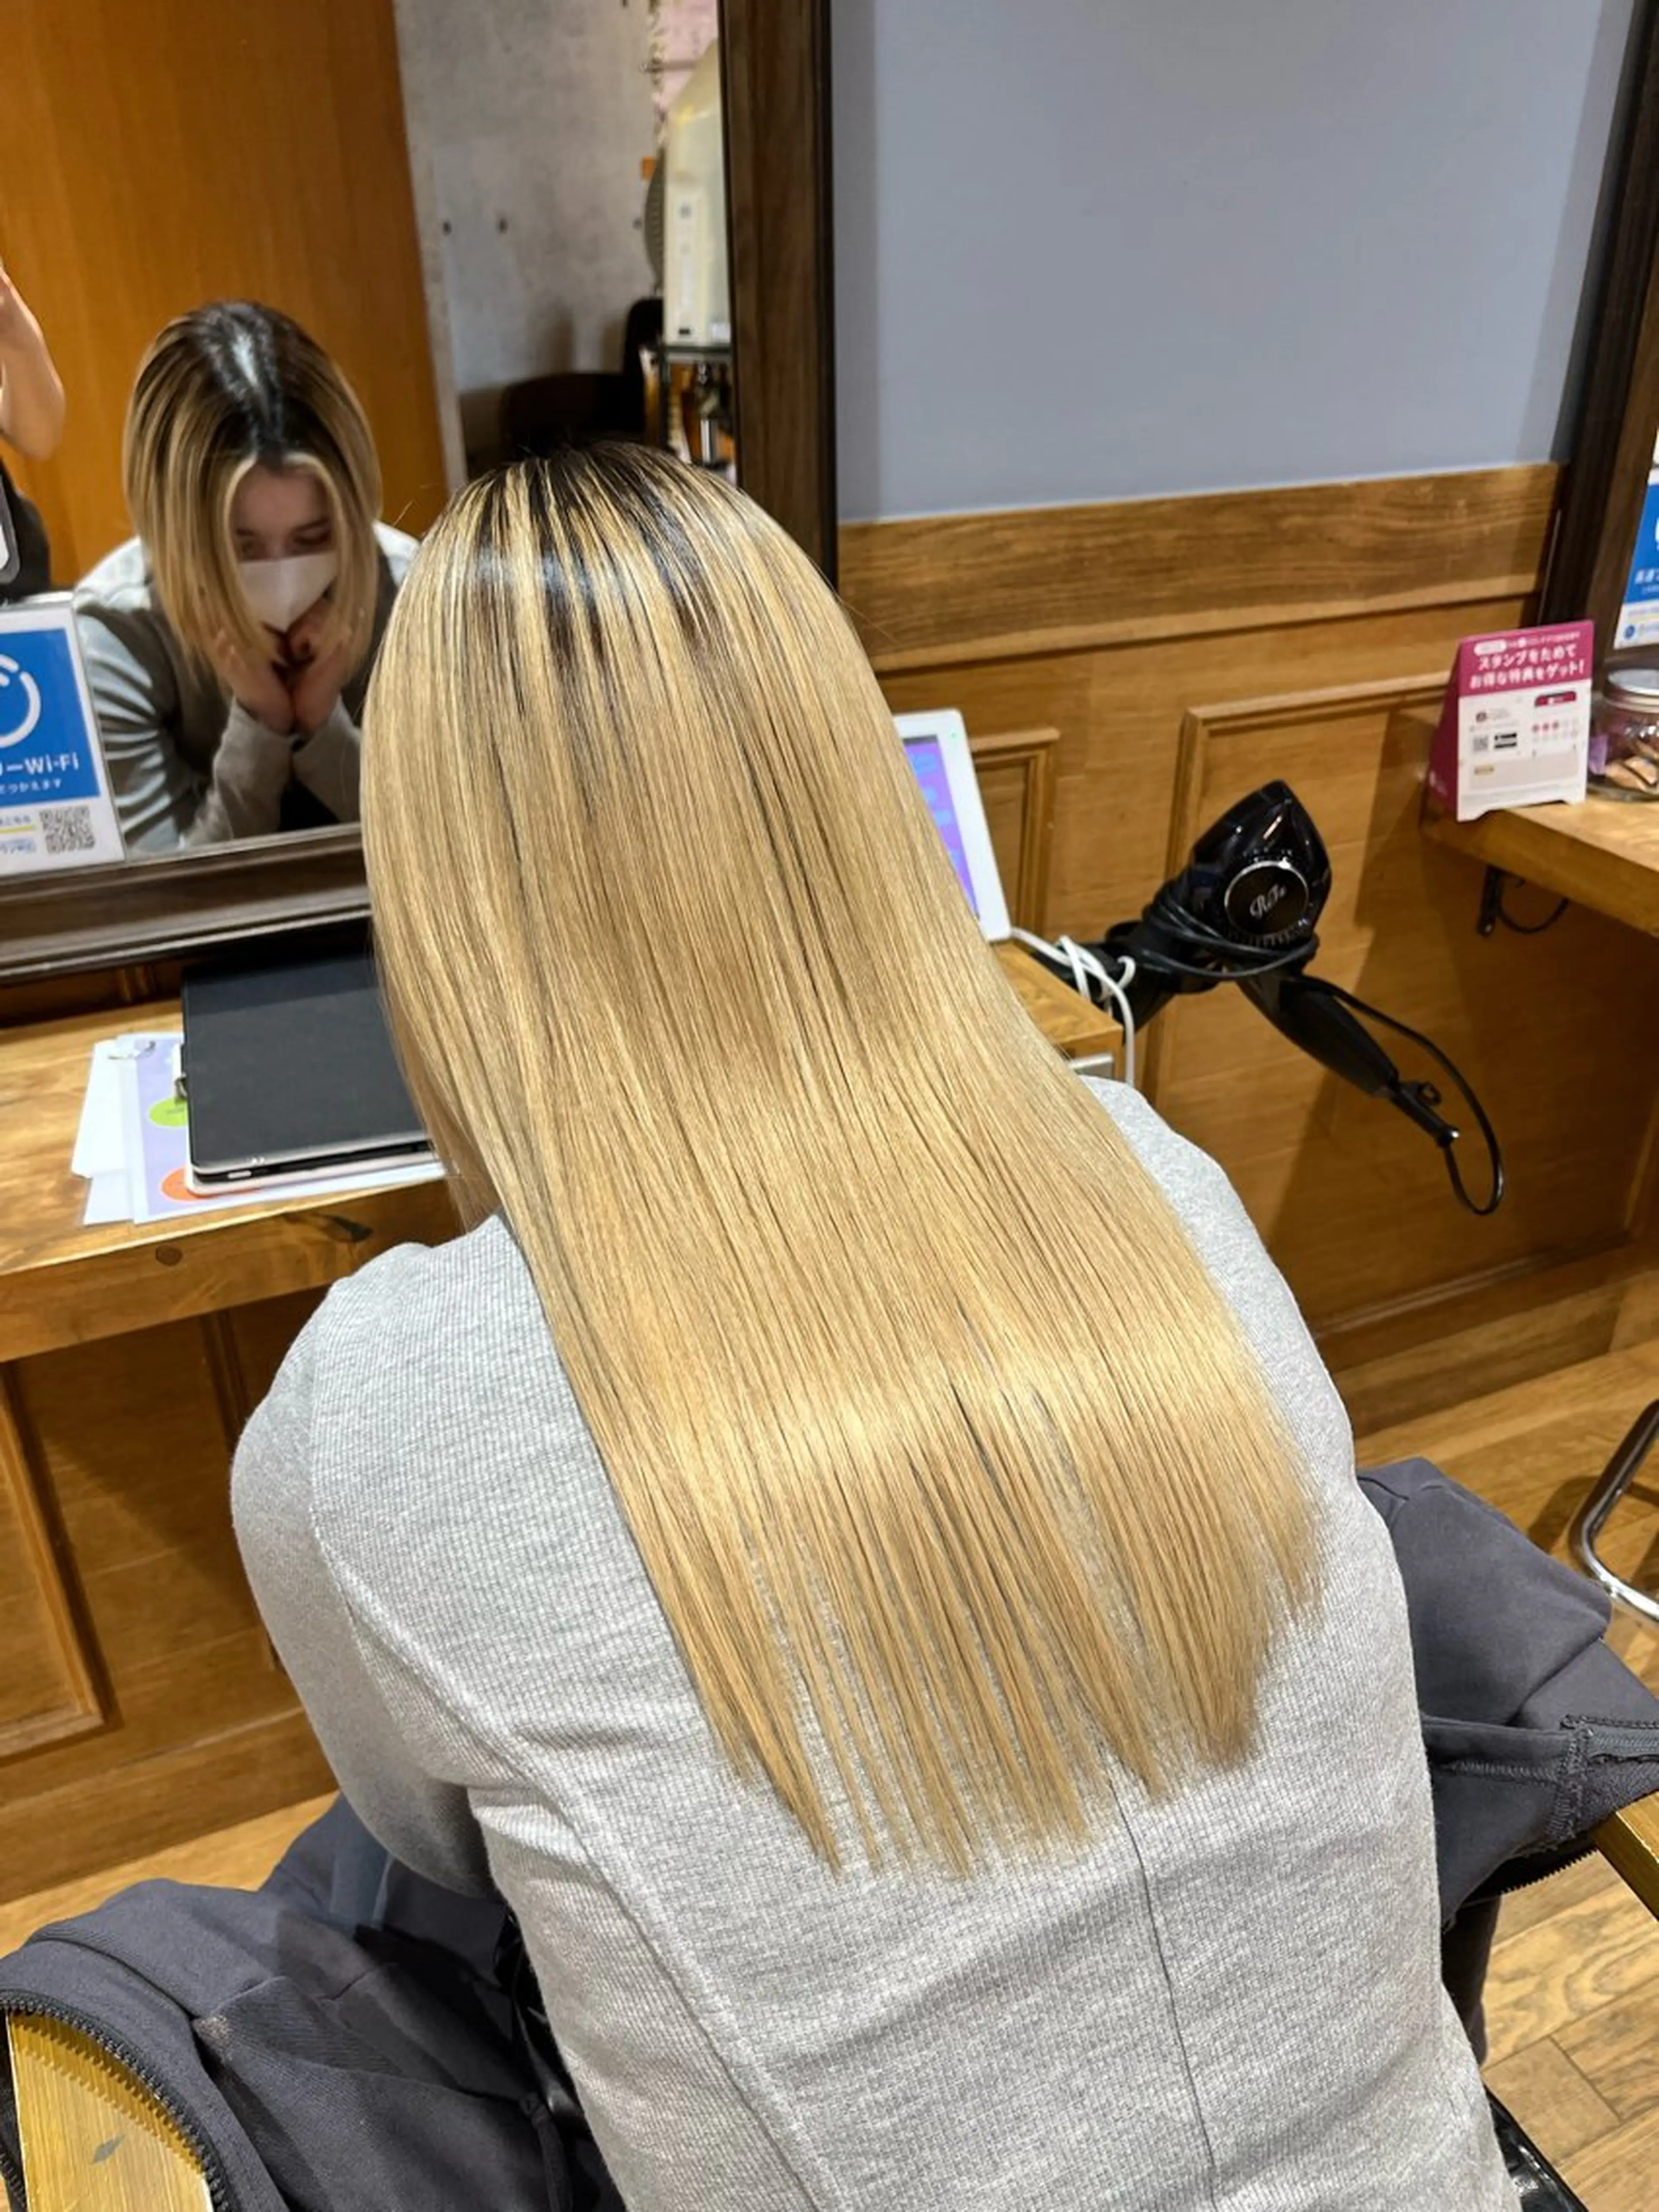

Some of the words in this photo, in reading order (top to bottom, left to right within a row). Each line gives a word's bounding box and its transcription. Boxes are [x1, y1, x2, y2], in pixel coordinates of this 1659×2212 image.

[1479, 643, 1576, 671] スタンプをためて
